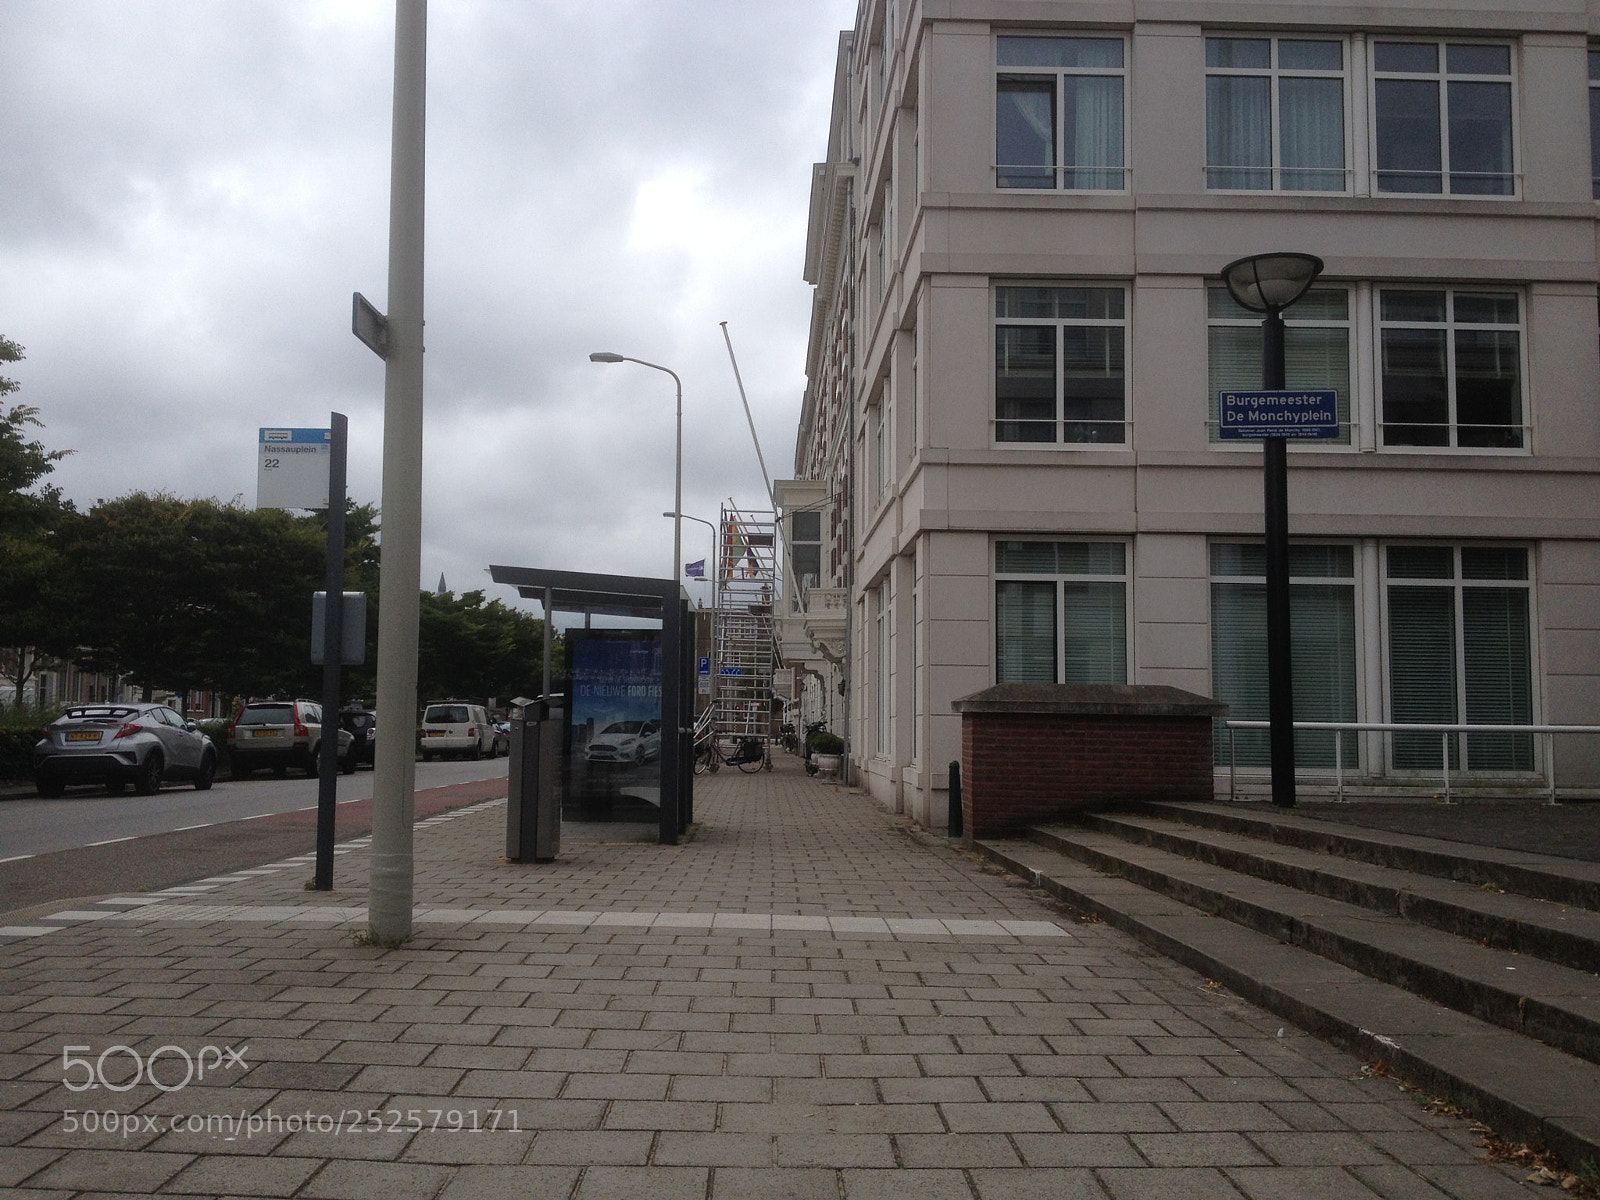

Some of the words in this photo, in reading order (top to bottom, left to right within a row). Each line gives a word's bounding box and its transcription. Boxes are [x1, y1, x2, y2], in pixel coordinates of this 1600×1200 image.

[1226, 394, 1322, 408] Burgemeester
[1227, 410, 1244, 421] De
[1248, 410, 1332, 423] Monchyplein
[264, 445, 317, 454] Nassauplein
[264, 458, 280, 468] 22
[580, 684, 592, 697] DE
[594, 684, 626, 697] NIEUWE
[627, 684, 646, 697] FORD
